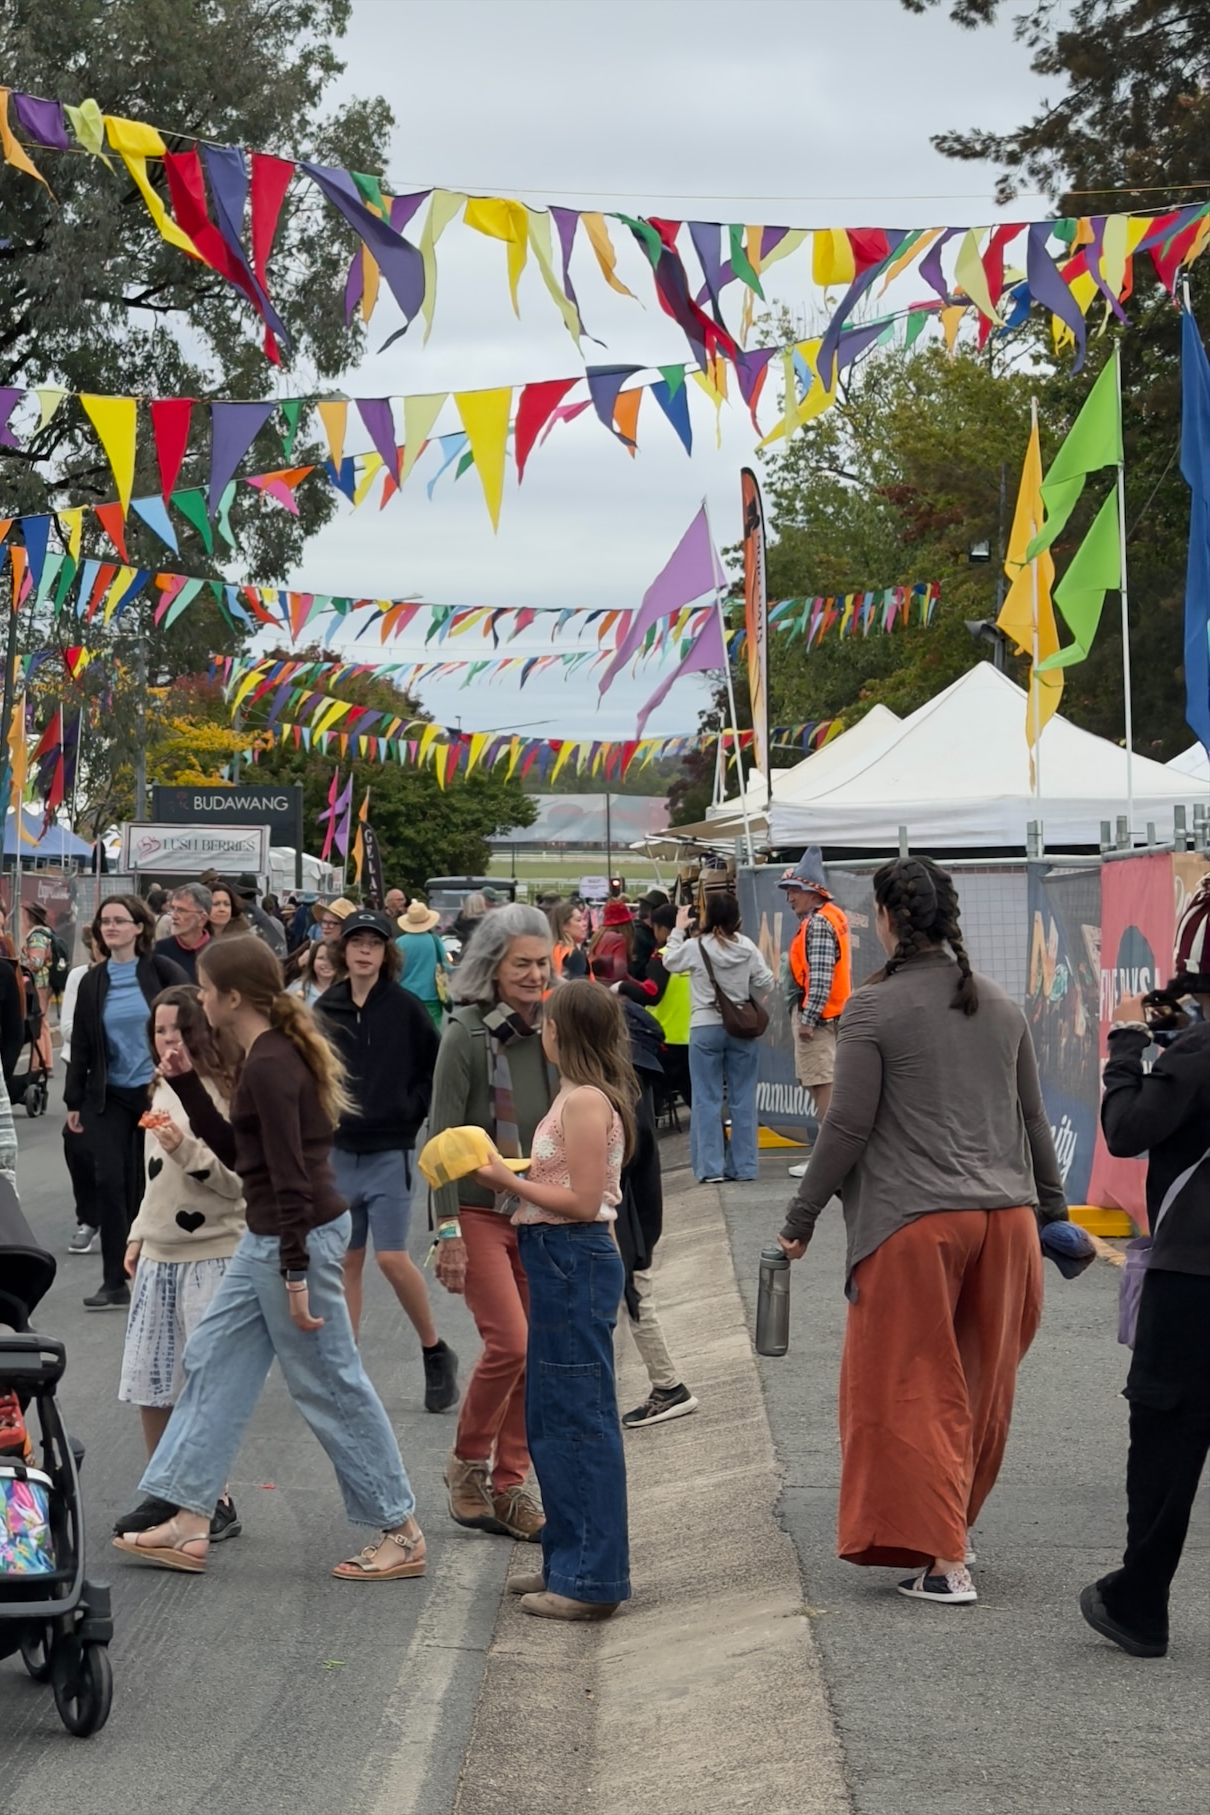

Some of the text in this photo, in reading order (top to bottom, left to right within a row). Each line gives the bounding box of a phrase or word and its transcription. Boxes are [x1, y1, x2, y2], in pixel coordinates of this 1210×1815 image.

[193, 796, 289, 811] BUDAWANG
[163, 838, 256, 853] LUSH BERRIES
